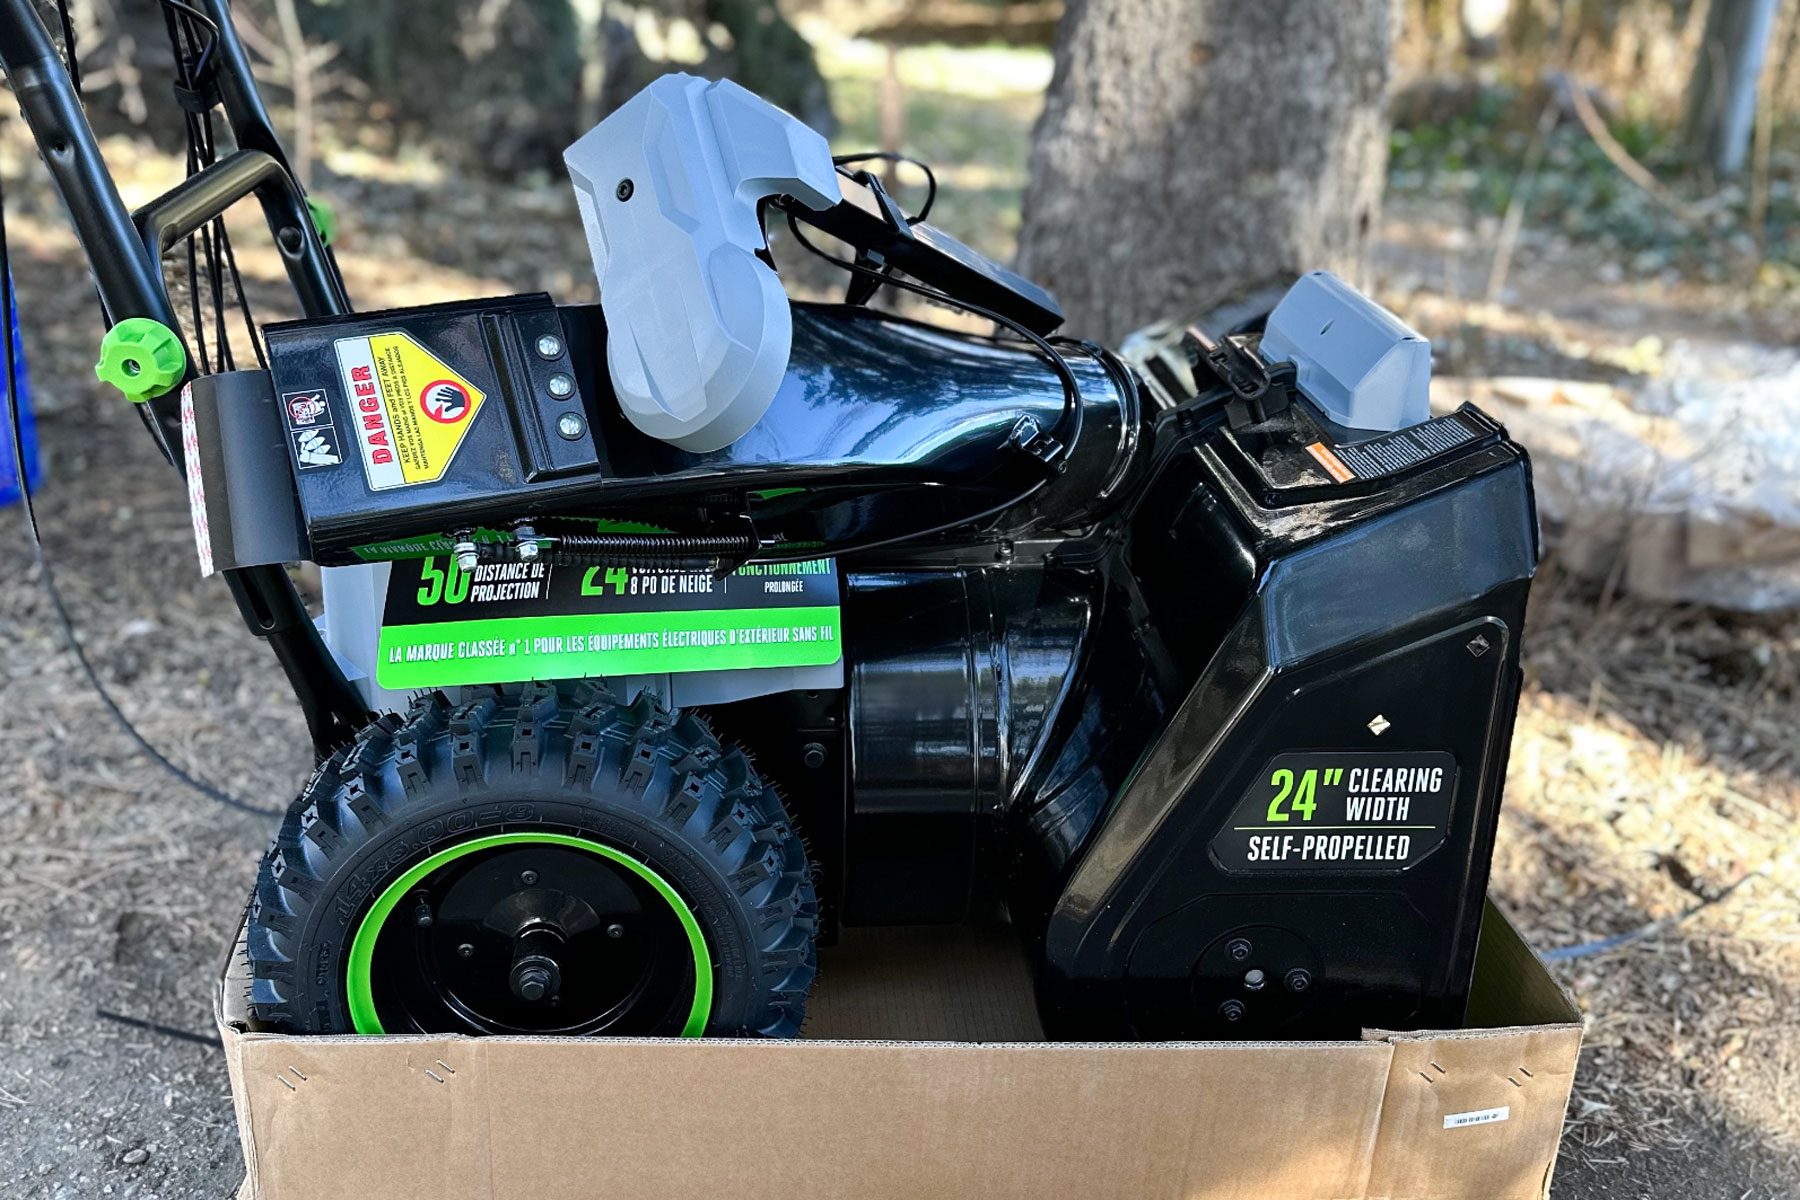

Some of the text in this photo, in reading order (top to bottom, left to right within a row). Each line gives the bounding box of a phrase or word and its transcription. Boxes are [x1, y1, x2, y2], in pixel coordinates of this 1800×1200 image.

[351, 365, 392, 464] DANGER
[378, 356, 410, 463] KEEP HANDS and FEET AWAY
[409, 405, 417, 426] MANOS
[474, 563, 528, 582] DISTANCE
[732, 558, 831, 576] ONCTIONNEMENT
[470, 582, 540, 602] PROJECTION
[581, 566, 628, 596] 24
[630, 574, 713, 594] 8 PO DE NEIGE
[764, 578, 804, 593] PROLONGÉE
[389, 646, 402, 663] LA
[406, 643, 454, 662] MARQUE
[458, 636, 505, 659] CLASSÉE
[534, 638, 562, 654] POUR
[566, 637, 584, 652] LES
[588, 632, 659, 651] ÉQUIPEMENTS
[662, 627, 726, 648] ÉLECTRIQUES
[730, 624, 790, 645] D'EXTÉRIEUR
[793, 626, 818, 642] SANS
[820, 625, 834, 641] FIL
[1348, 768, 1443, 794] CLEARING
[1267, 768, 1344, 822] 24"
[1346, 797, 1410, 822] WIDTH
[1247, 834, 1411, 862] SELF-PROPELLED
